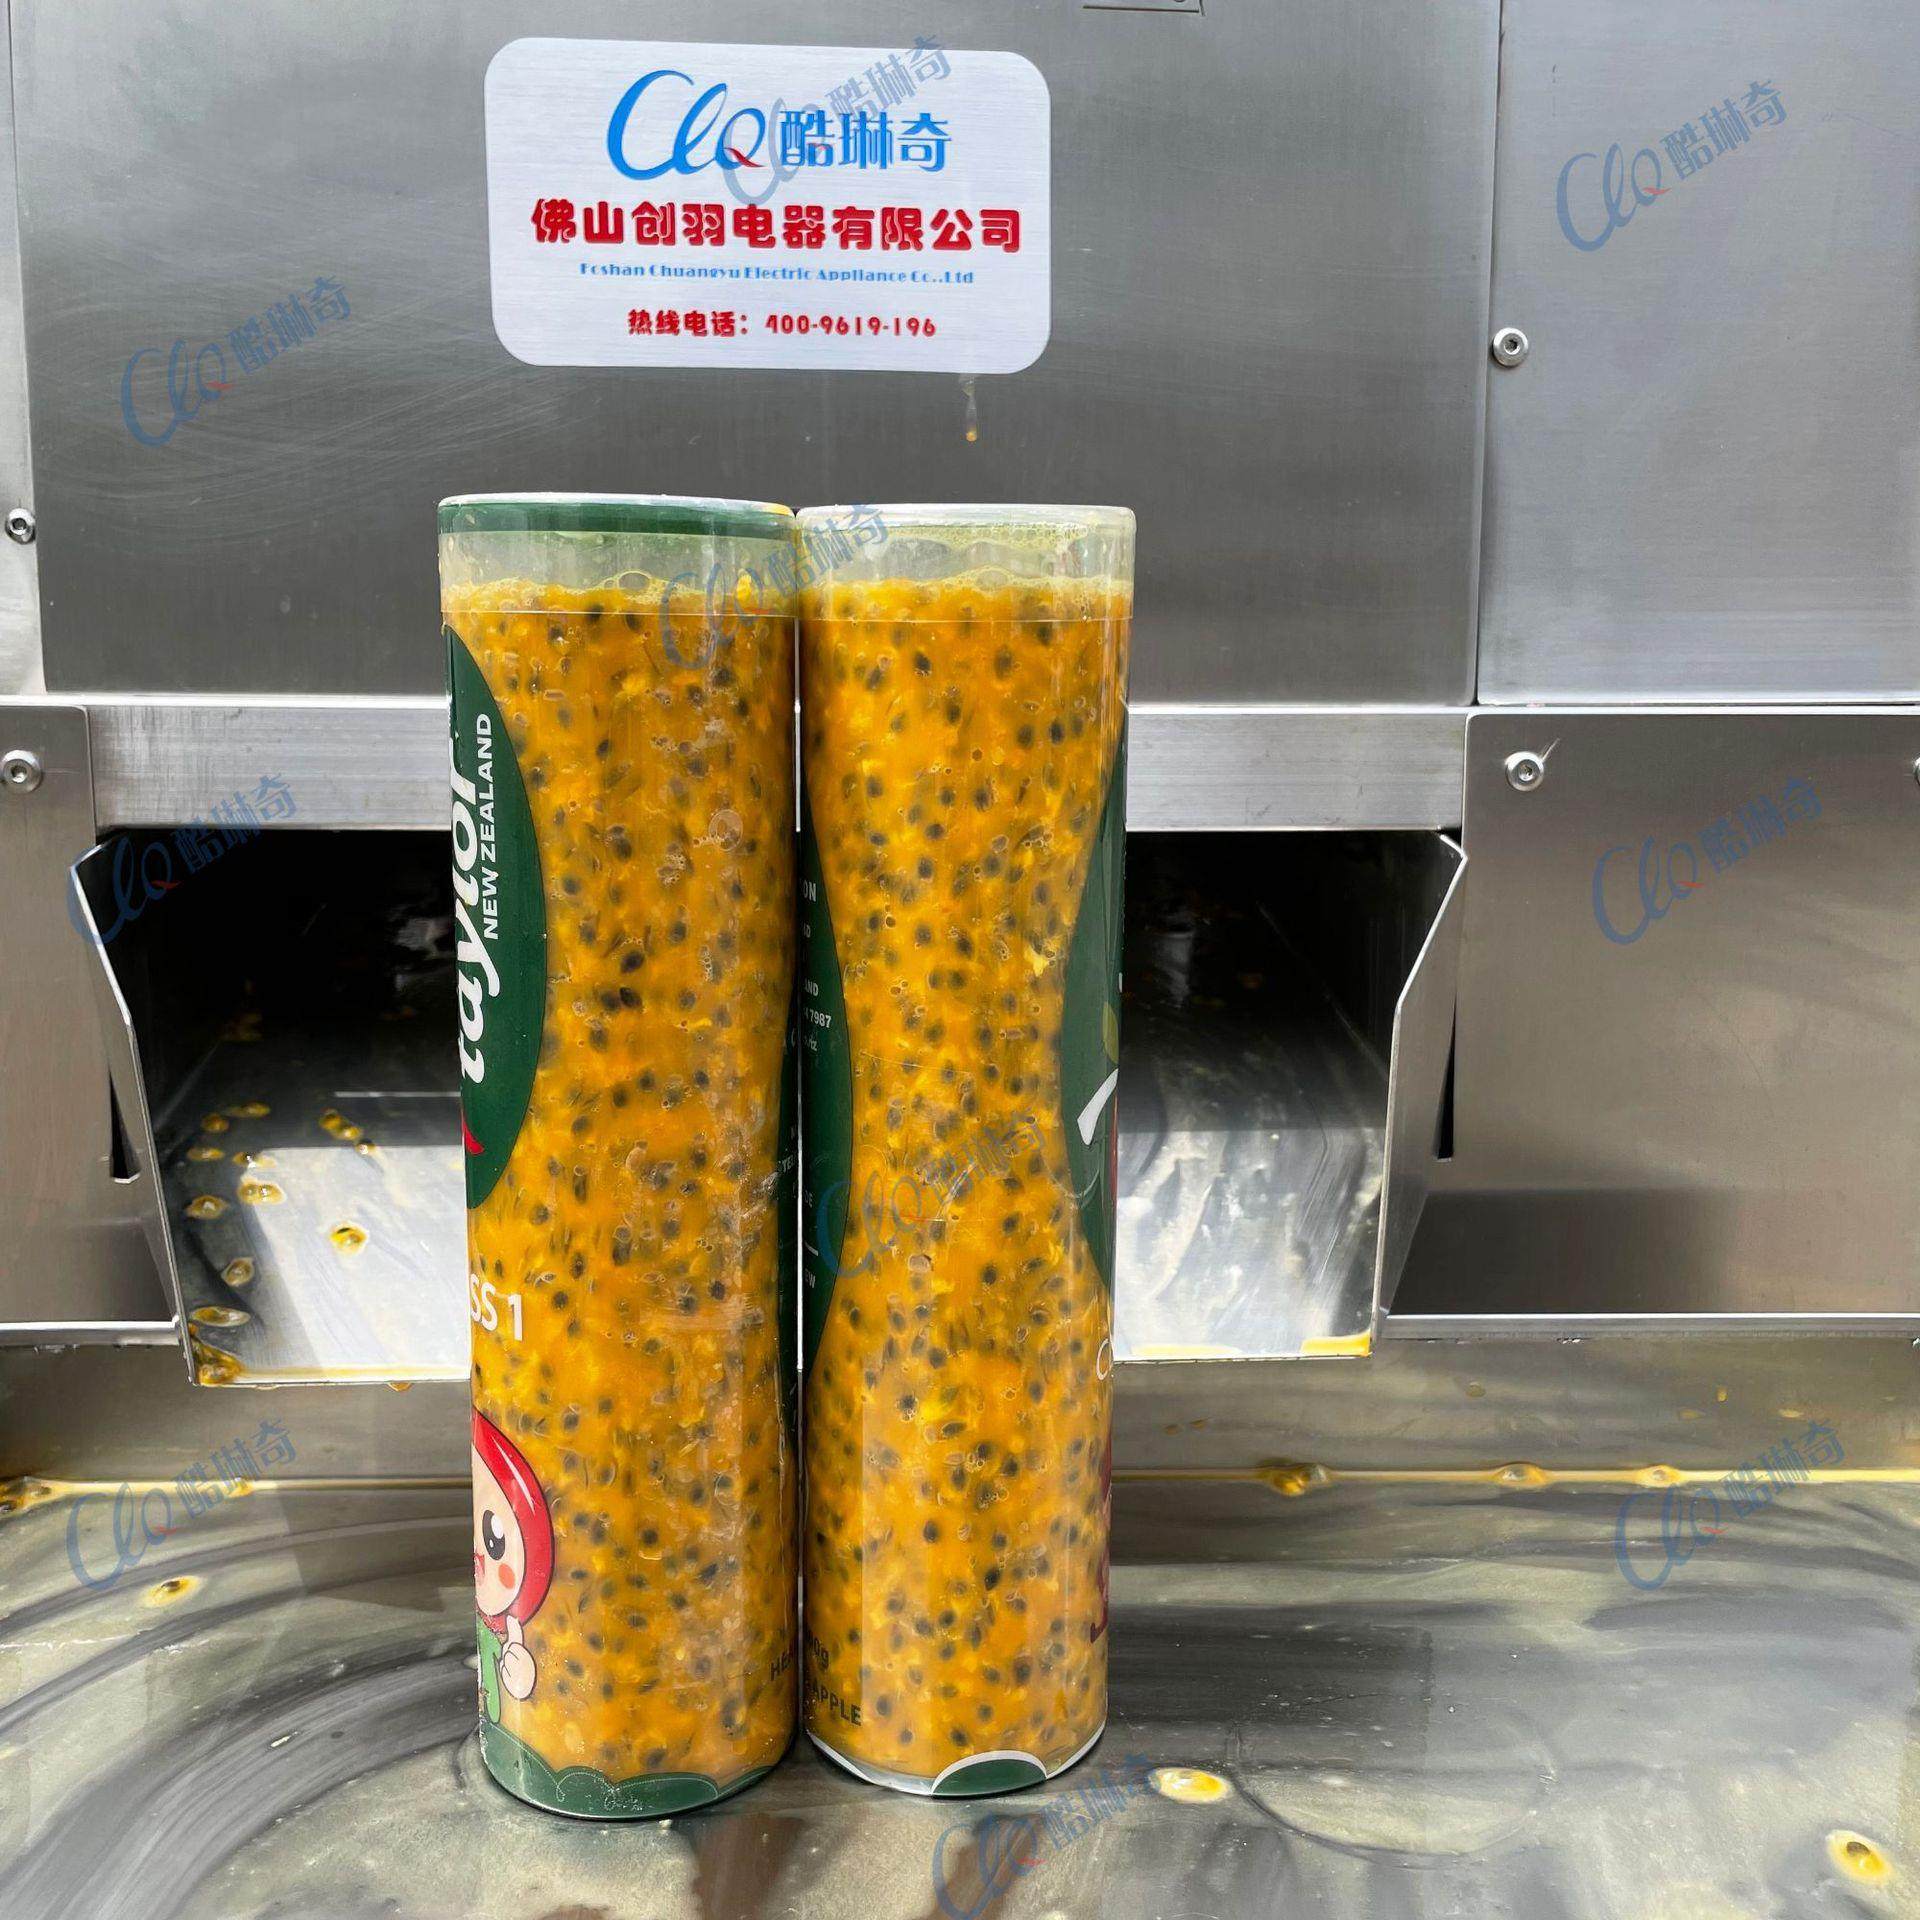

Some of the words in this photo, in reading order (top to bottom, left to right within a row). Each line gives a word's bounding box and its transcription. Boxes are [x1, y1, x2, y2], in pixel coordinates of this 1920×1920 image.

[779, 110, 952, 173] 酷琳奇
[531, 198, 1021, 253] 佛山创羽电器有限公司
[580, 261, 646, 277] Foshan
[649, 262, 741, 280] Chuangyu
[744, 266, 813, 282] Electric
[816, 267, 907, 284] Appliance
[765, 313, 937, 338] 400-9619-196
[475, 713, 497, 863] ZEALAND
[481, 866, 499, 940] NEW
[508, 1293, 523, 1341] 1
